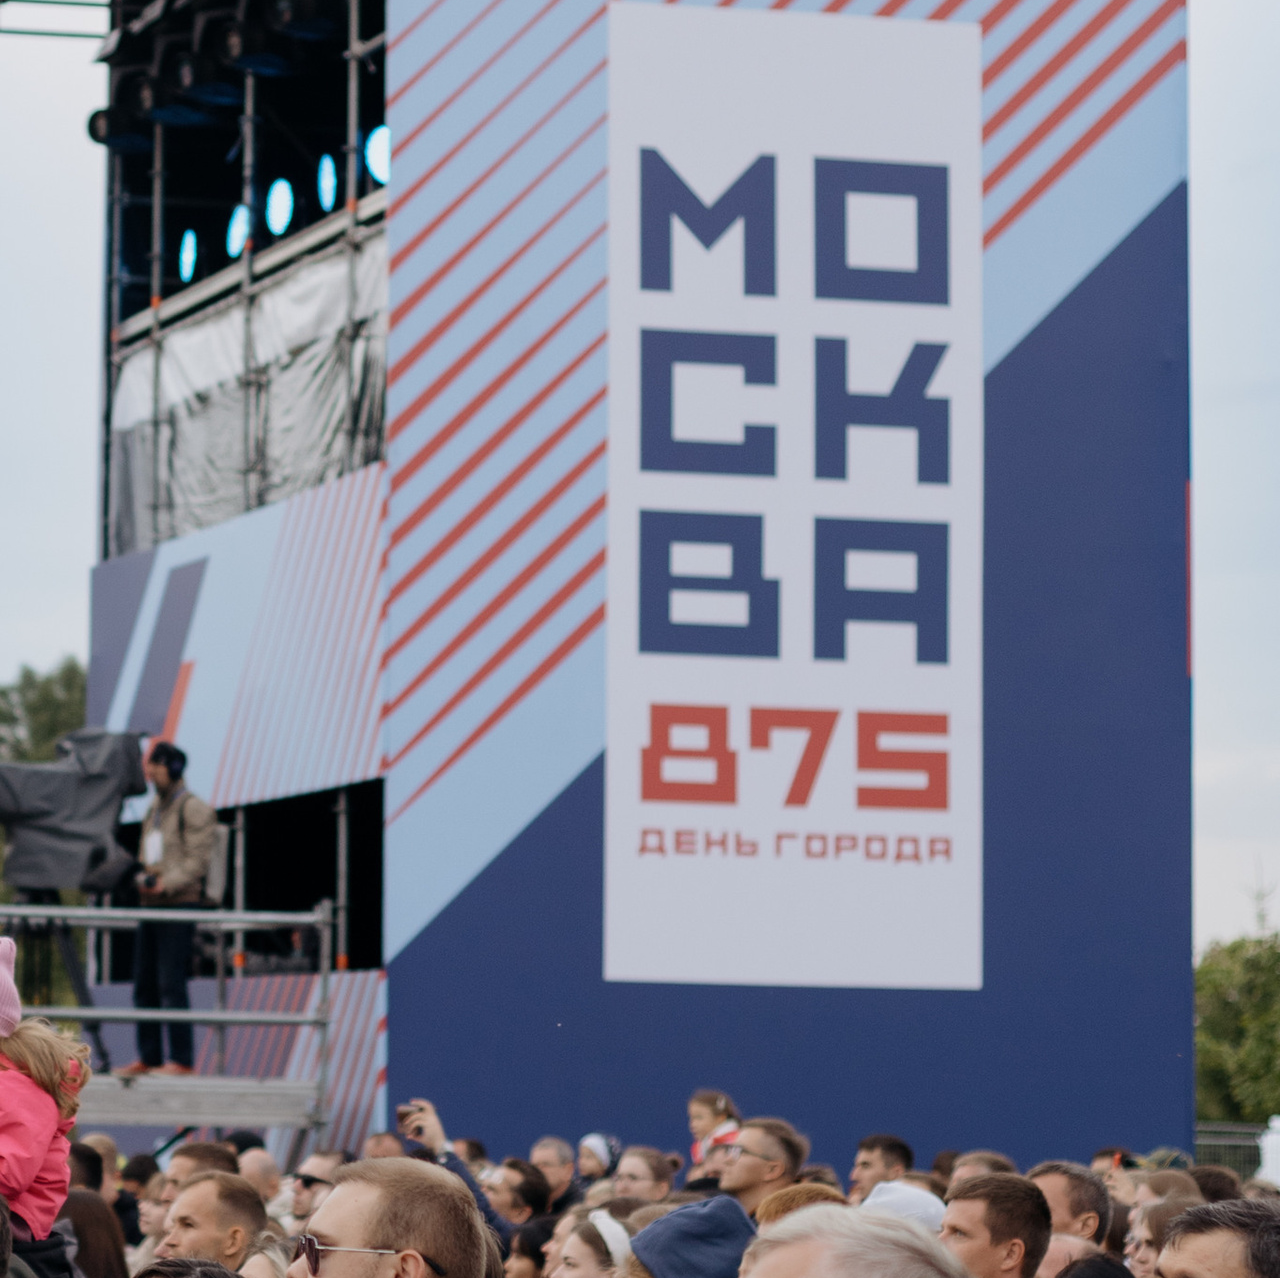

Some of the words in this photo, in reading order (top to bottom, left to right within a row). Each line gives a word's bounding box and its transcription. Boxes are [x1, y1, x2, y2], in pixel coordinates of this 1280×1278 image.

[640, 146, 949, 305] МО
[640, 328, 950, 485] СК
[639, 509, 949, 665] ВА
[641, 703, 949, 811] 875
[639, 827, 759, 857] ДЕНЬ
[775, 831, 952, 863] ГОРОДА
